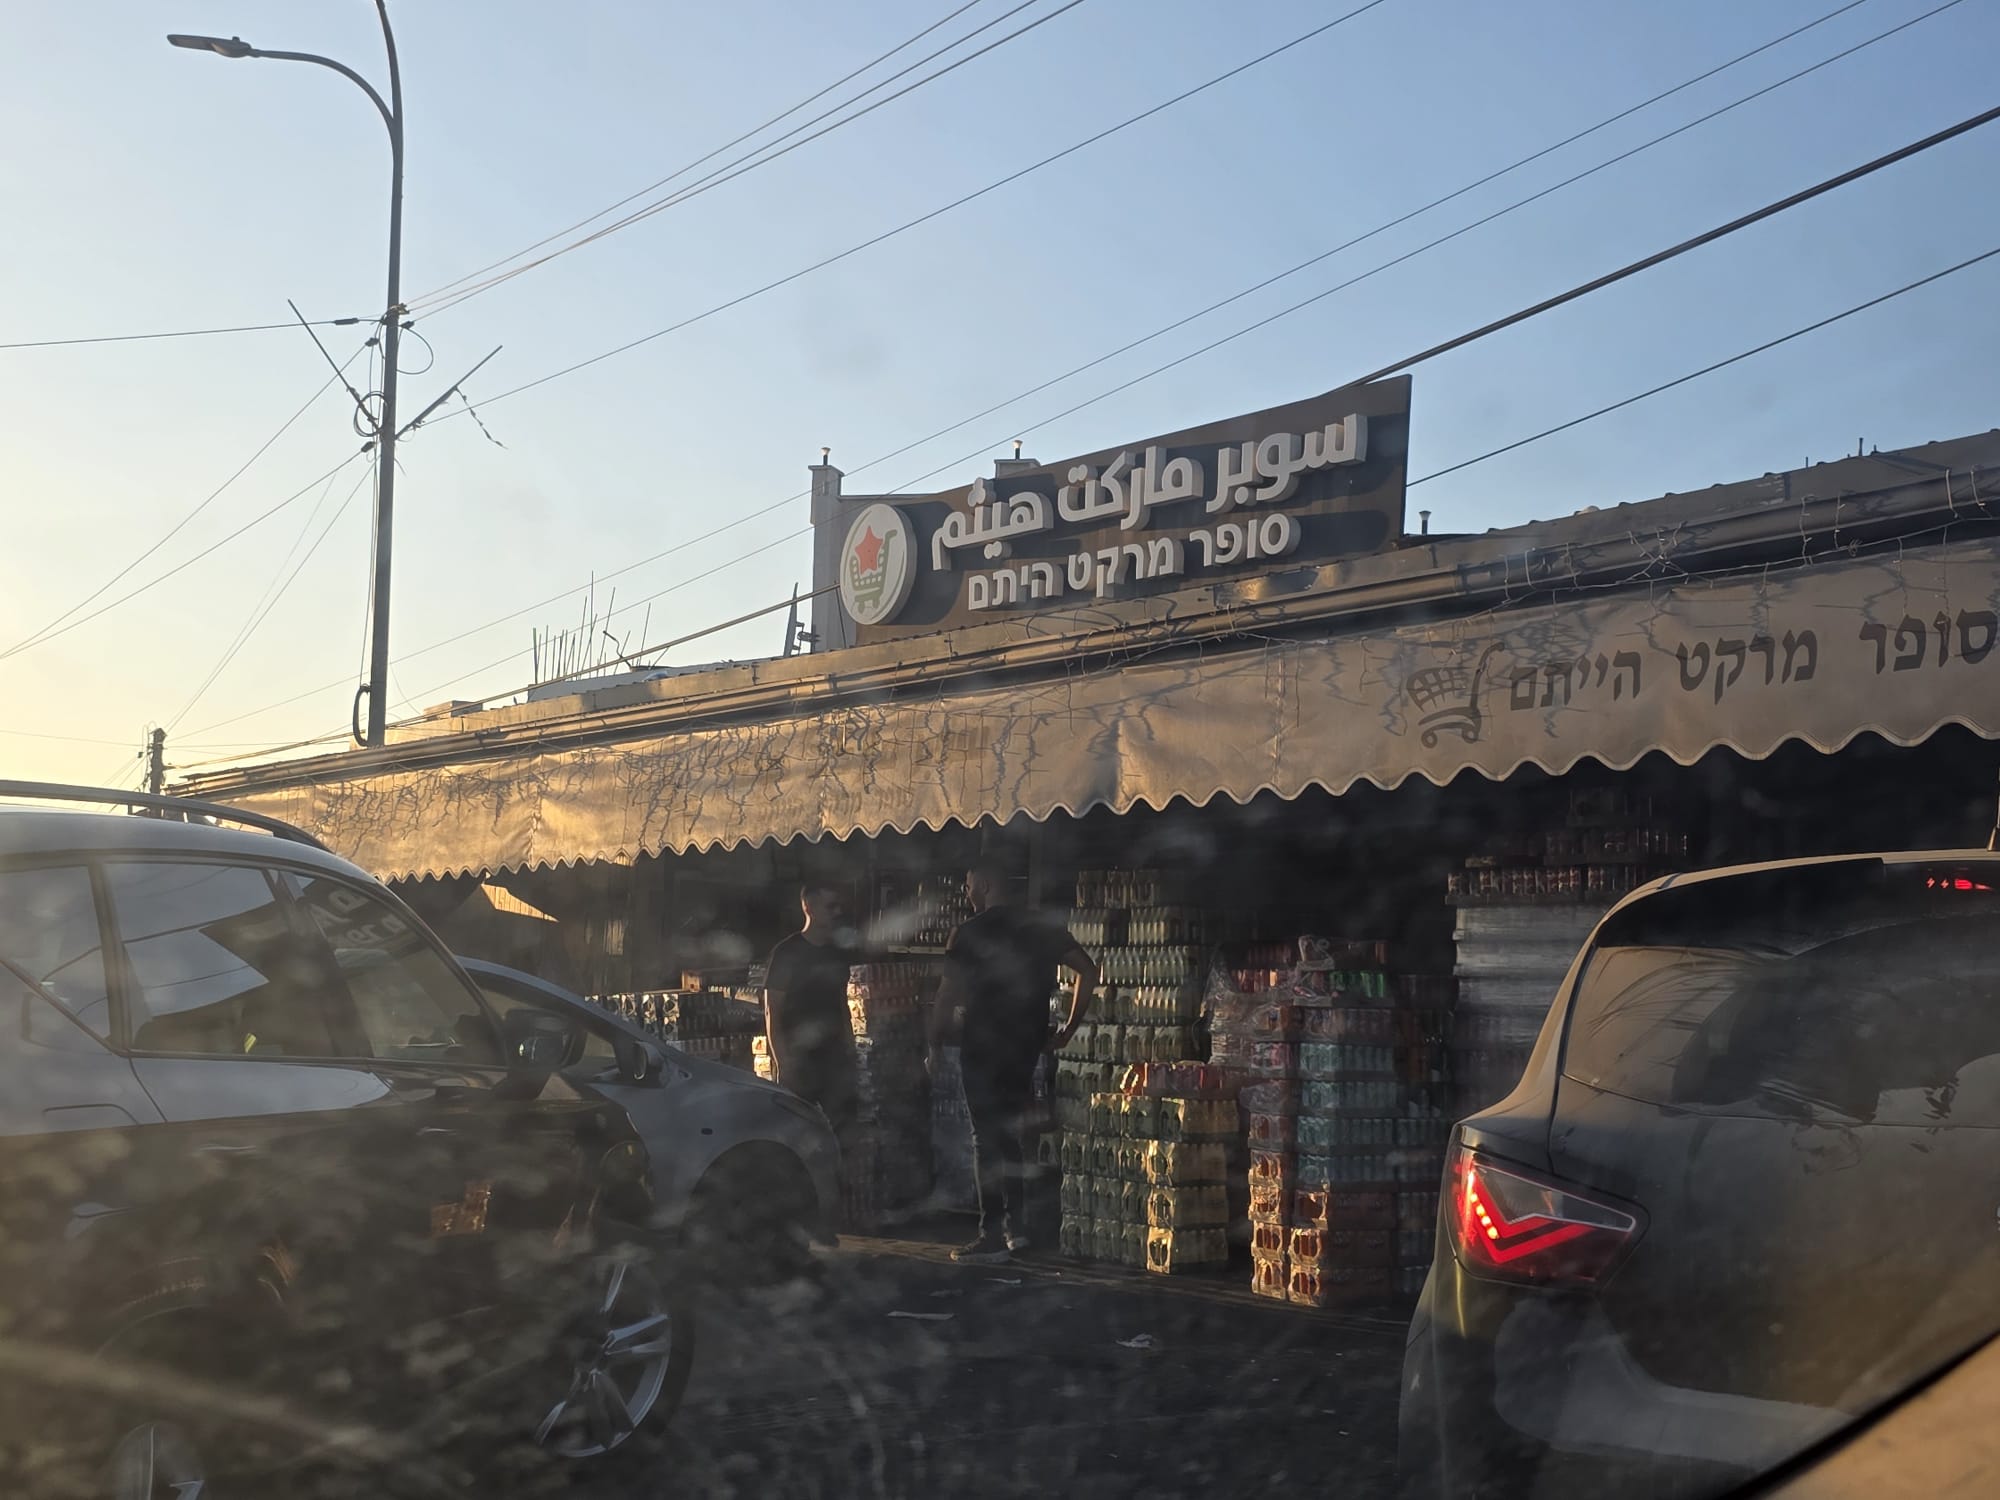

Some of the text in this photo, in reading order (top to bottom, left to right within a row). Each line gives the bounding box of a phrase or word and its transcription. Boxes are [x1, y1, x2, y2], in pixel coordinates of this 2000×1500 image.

[931, 413, 1364, 571] سوبر ماركت هيثم
[968, 513, 1297, 611] סופר מרקט היתם
[1508, 608, 2000, 712] סופר מרקט הייתם
